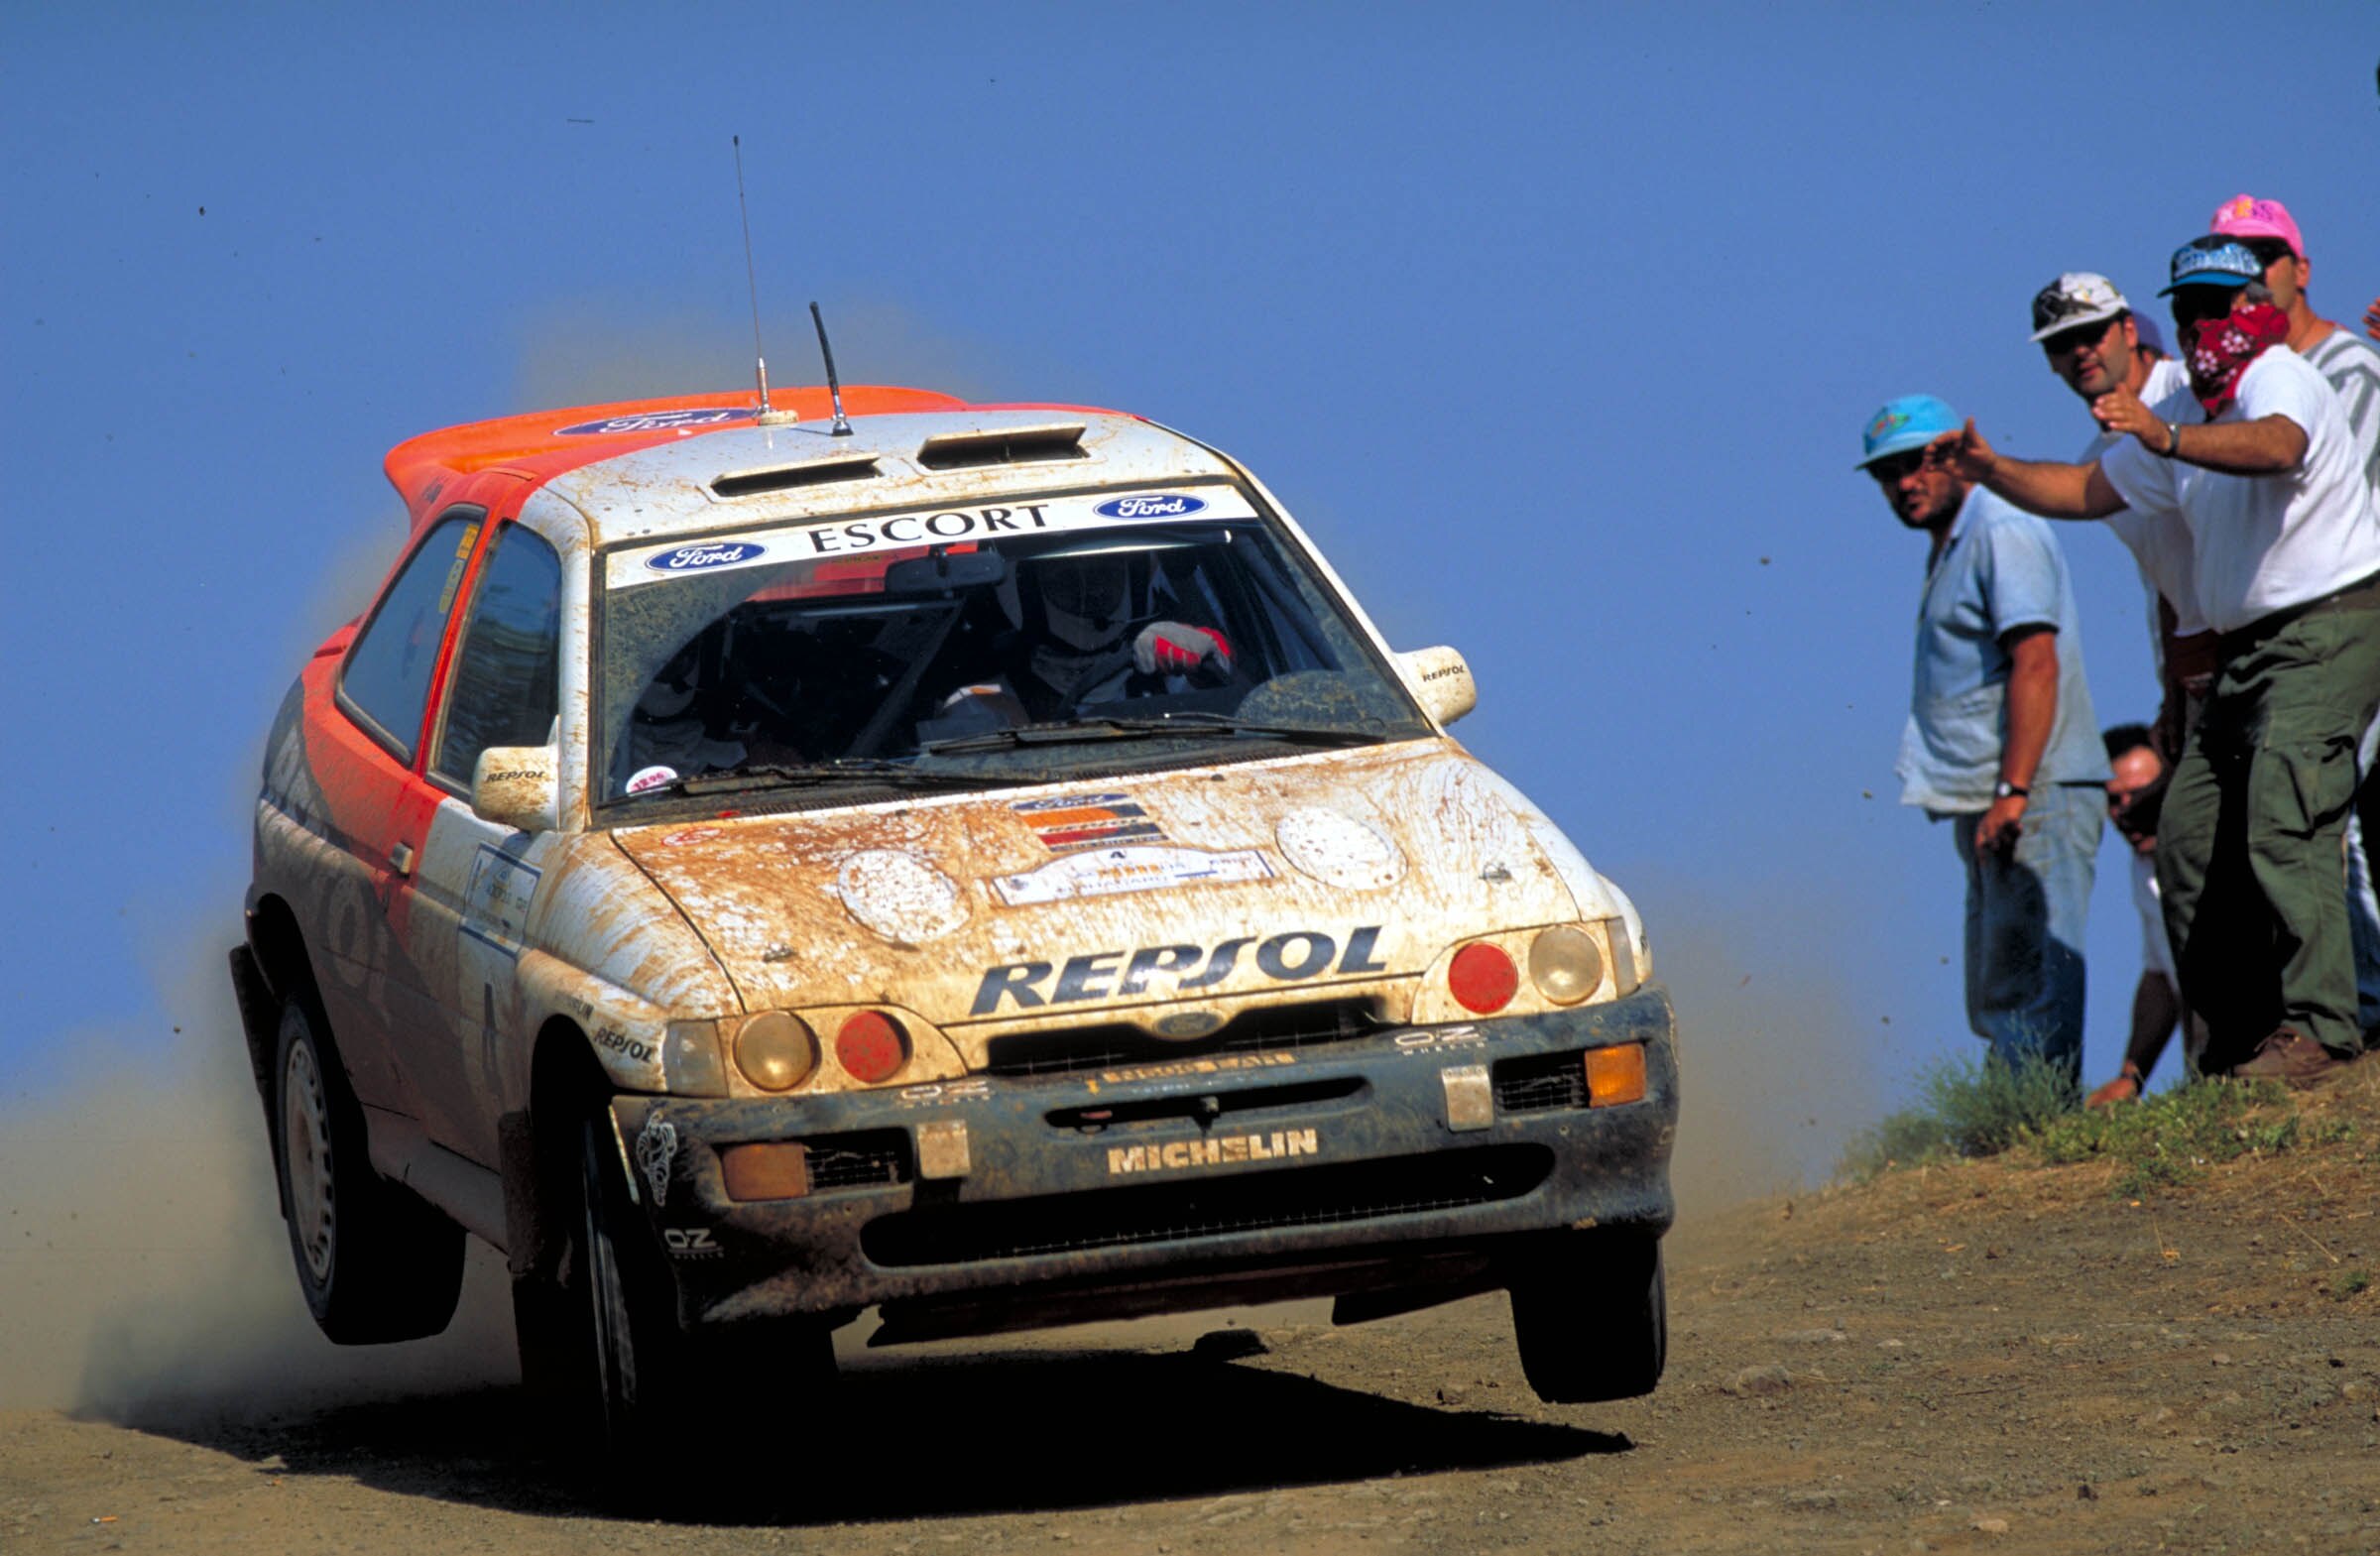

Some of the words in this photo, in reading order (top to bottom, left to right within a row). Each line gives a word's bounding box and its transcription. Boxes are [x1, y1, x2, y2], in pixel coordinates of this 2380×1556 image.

[599, 411, 732, 433] Ford
[1118, 496, 1187, 517] Ford
[807, 504, 1050, 553] ESCORT
[669, 544, 744, 569] Ford
[1422, 663, 1466, 683] REPSOL
[969, 926, 1387, 1016] REPSOL
[594, 1025, 654, 1064] REPSOL
[1107, 1129, 1319, 1175] MICHELIN
